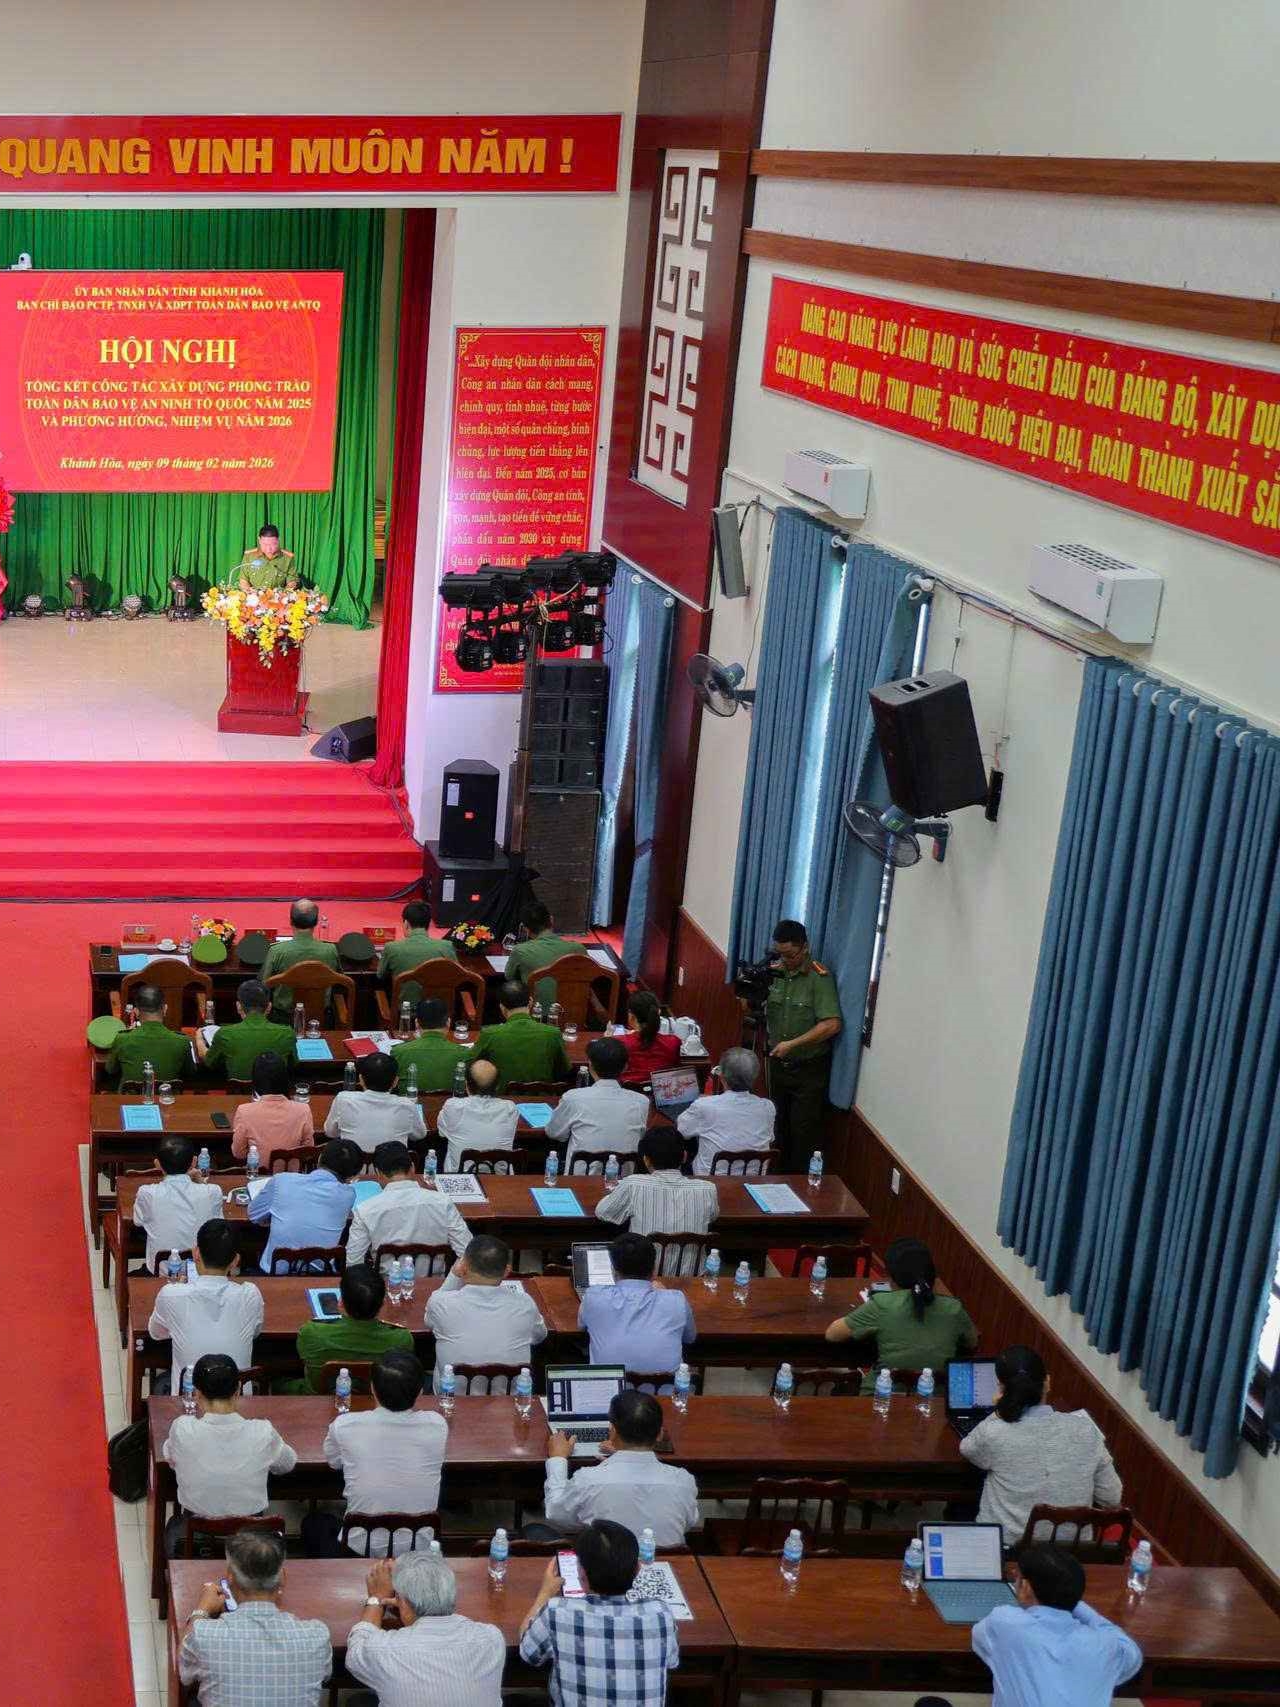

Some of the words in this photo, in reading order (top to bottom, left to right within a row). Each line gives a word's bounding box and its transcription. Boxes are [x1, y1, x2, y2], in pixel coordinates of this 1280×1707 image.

[169, 137, 273, 174] VINH
[290, 128, 424, 174] MUÔN
[439, 127, 546, 174] NĂM
[560, 137, 573, 174] !
[17, 300, 39, 310] BAN
[92, 287, 113, 297] BAN
[99, 335, 154, 369] HỘI
[162, 338, 237, 369] NGHỊ
[800, 297, 826, 337] NÂNG
[827, 309, 847, 342] CAO
[847, 307, 876, 349] NĂNG
[877, 318, 899, 361] LỰC
[899, 317, 930, 363] LÃNH
[931, 331, 955, 375] ĐẠO
[958, 329, 975, 374] VÀ
[977, 333, 1004, 381] SỨC
[1006, 333, 1049, 392] CHIẾN
[1050, 339, 1082, 401] ĐẤU
[1084, 352, 1116, 410] CỦA
[1120, 359, 1168, 422] ĐẢNG
[1170, 375, 1198, 438] BỘ,
[1205, 384, 1248, 441] XÂY
[775, 337, 798, 378] CÁCH
[798, 352, 826, 392] MẠNG,
[829, 355, 858, 398] CHÍNH
[885, 376, 910, 414] TINH
[911, 382, 942, 431] NHUỆ,
[947, 386, 979, 436] TỪNG
[980, 398, 1016, 447] BƯỚC
[1019, 409, 1053, 462] HIỆN
[1054, 424, 1082, 474] ĐẠI,
[1088, 427, 1134, 483] HOÀN
[1137, 440, 1195, 502] THÀNH
[1196, 448, 1249, 517] XUẤT
